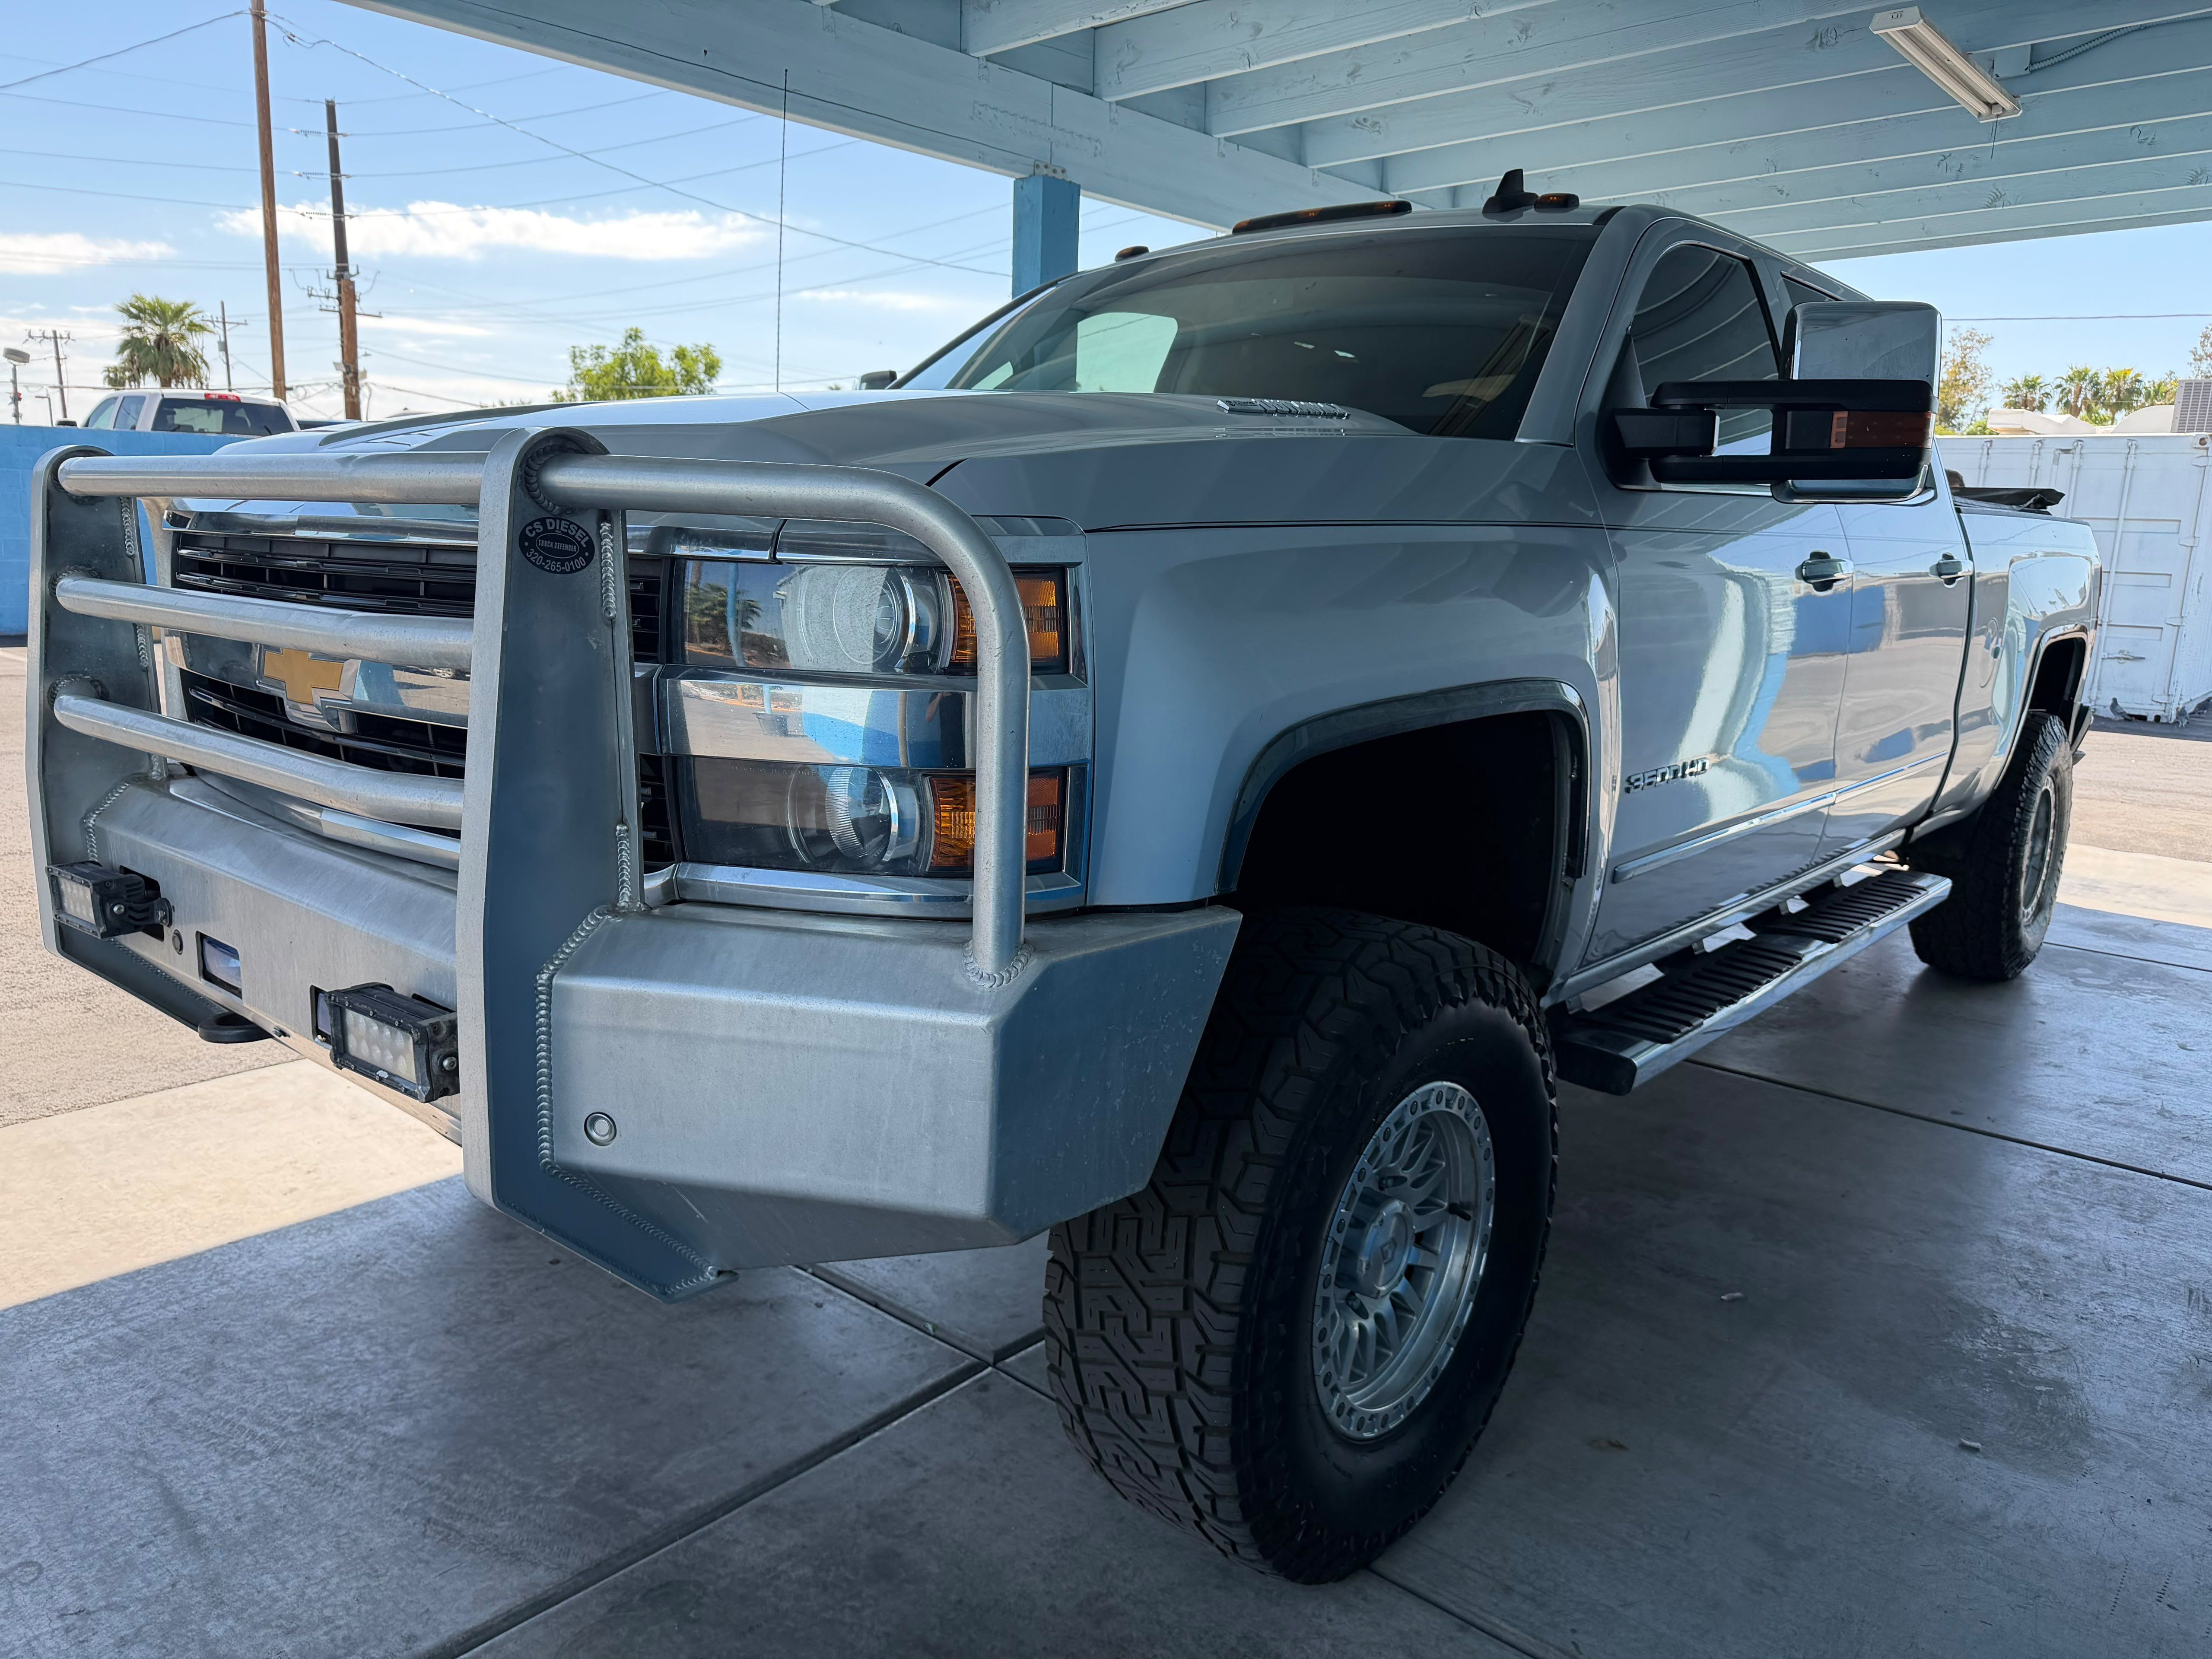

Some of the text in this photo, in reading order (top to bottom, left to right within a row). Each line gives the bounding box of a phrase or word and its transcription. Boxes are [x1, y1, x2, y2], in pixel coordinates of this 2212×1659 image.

[525, 518, 589, 547] CS DIESEL
[538, 539, 576, 553] TRUCK DEFENDER
[526, 548, 586, 572] 320-265-0100
